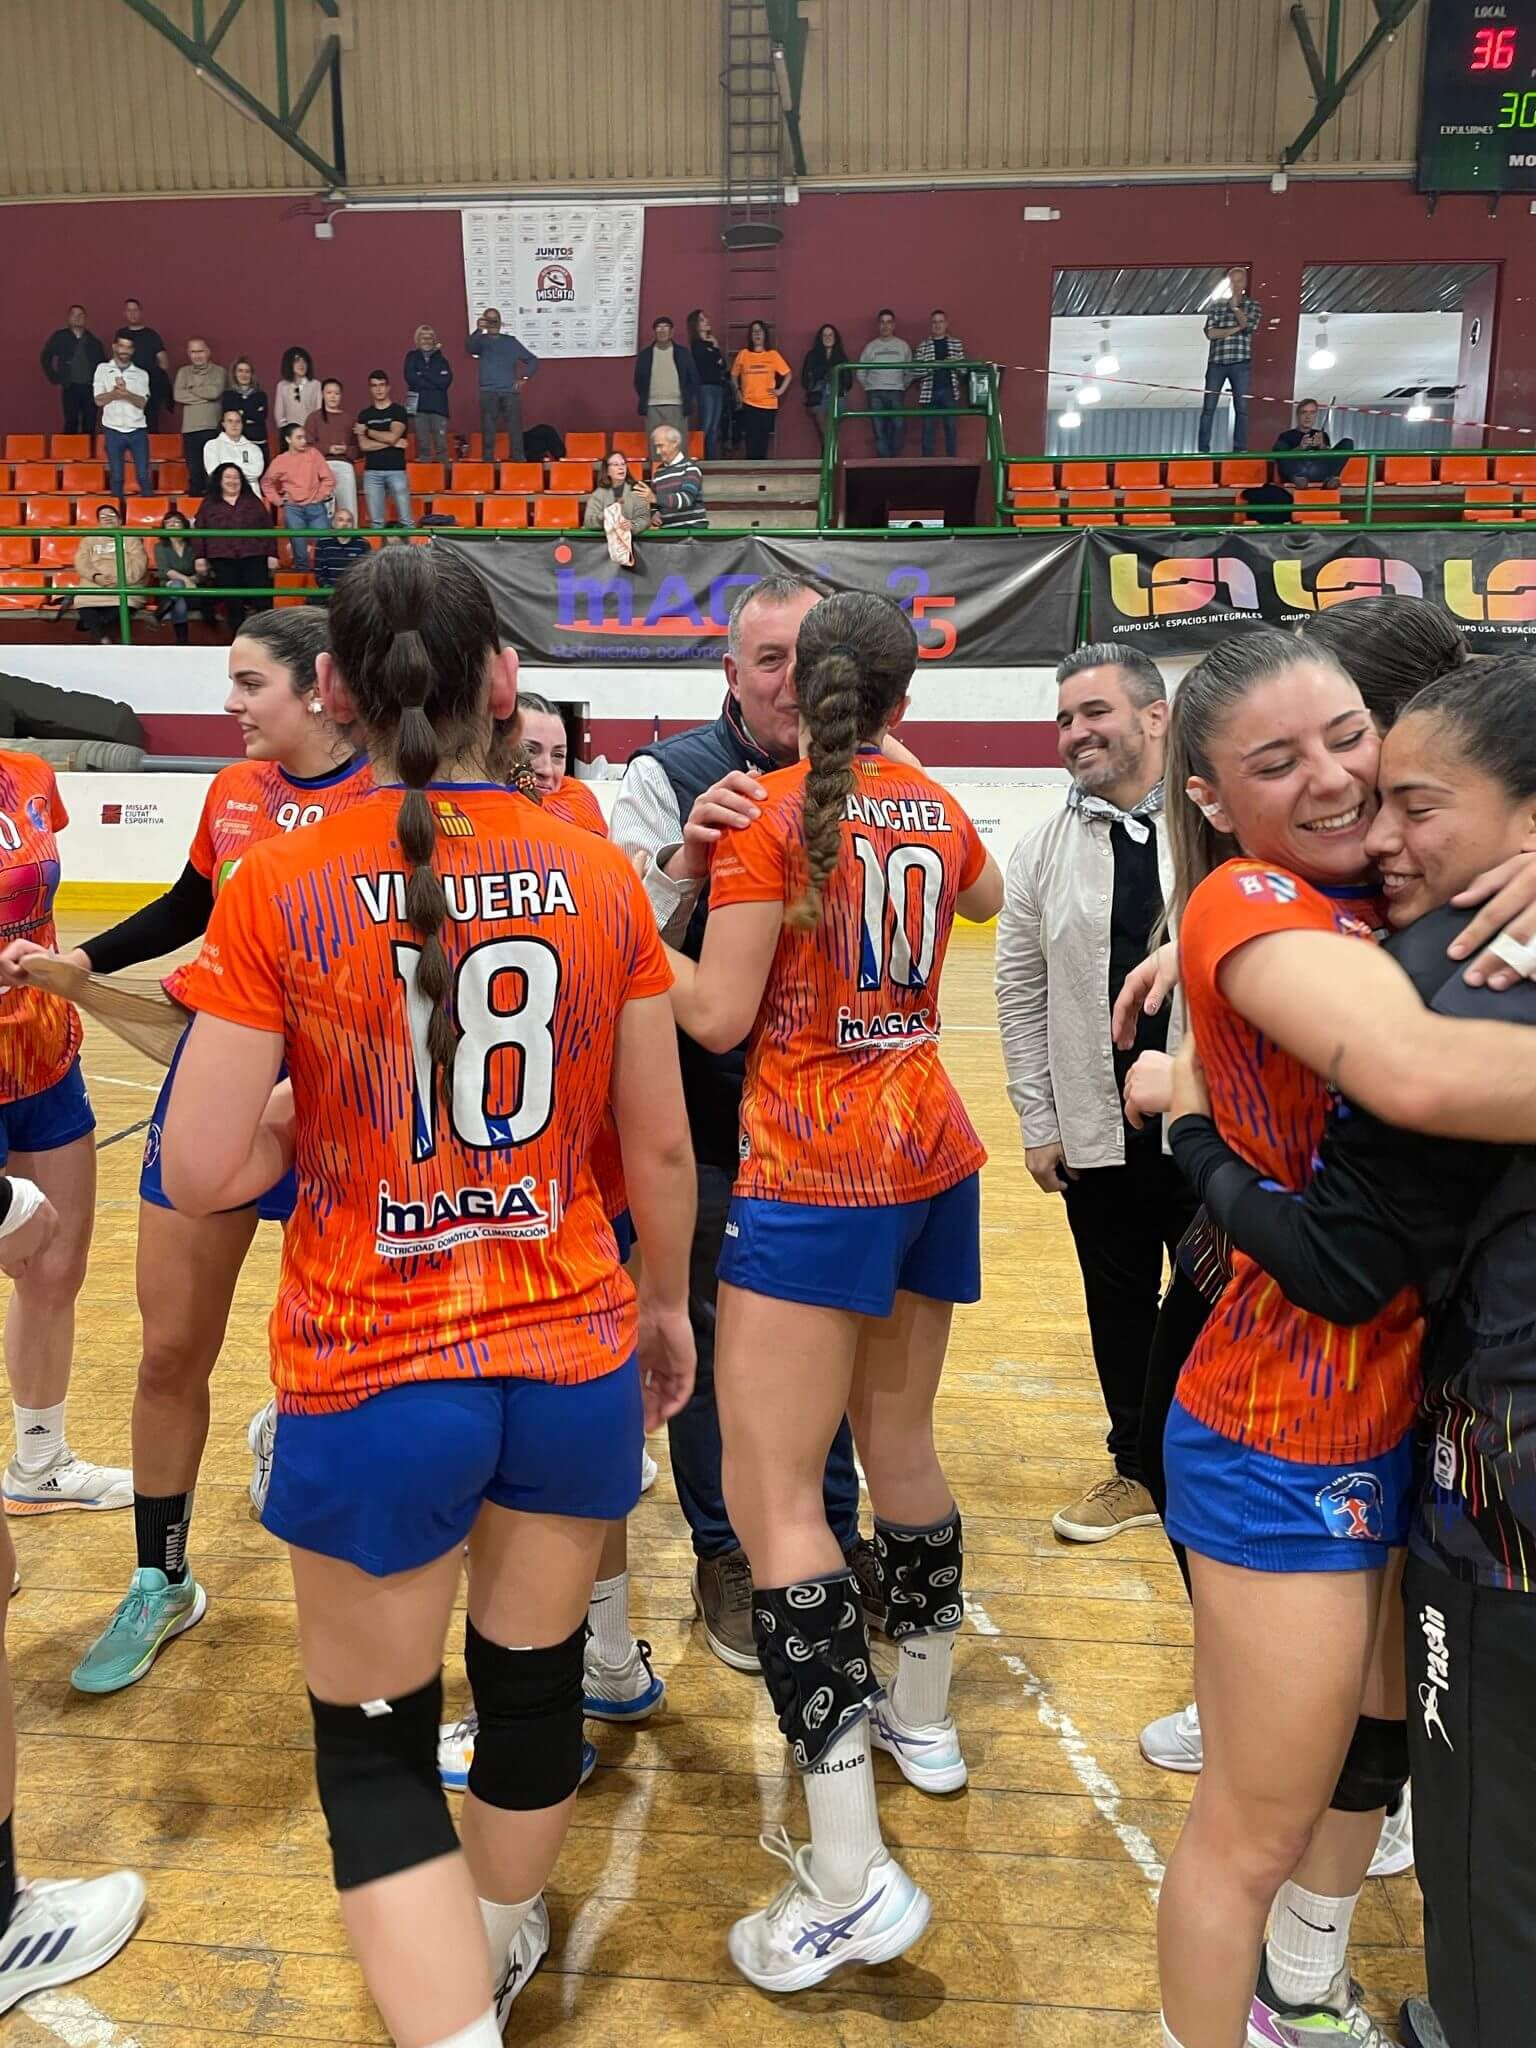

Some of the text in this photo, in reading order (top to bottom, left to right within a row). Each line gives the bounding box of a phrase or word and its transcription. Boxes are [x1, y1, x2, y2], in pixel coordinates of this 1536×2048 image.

[1474, 6, 1507, 18] LOCAL
[1470, 29, 1518, 70] 36
[1440, 125, 1493, 135] EXPULSIONES
[535, 247, 574, 256] JUNTOS
[536, 288, 574, 301] MISLATA
[1112, 623, 1141, 634] GRUPO
[1143, 621, 1160, 631] USA
[1166, 615, 1208, 628] ESPACIOS
[1209, 611, 1263, 623] INTEGRALES
[1280, 613, 1311, 622] GRUPO
[1478, 625, 1496, 633] USA
[839, 793, 952, 832] ANCHEZ
[971, 817, 1001, 826] tament
[352, 869, 579, 926] VIUERA
[853, 833, 945, 992] 10
[393, 935, 562, 1164] 18
[377, 1226, 547, 1256] ELECTRICIDAD DOMÓTICA CLIMATIZACIÓN
